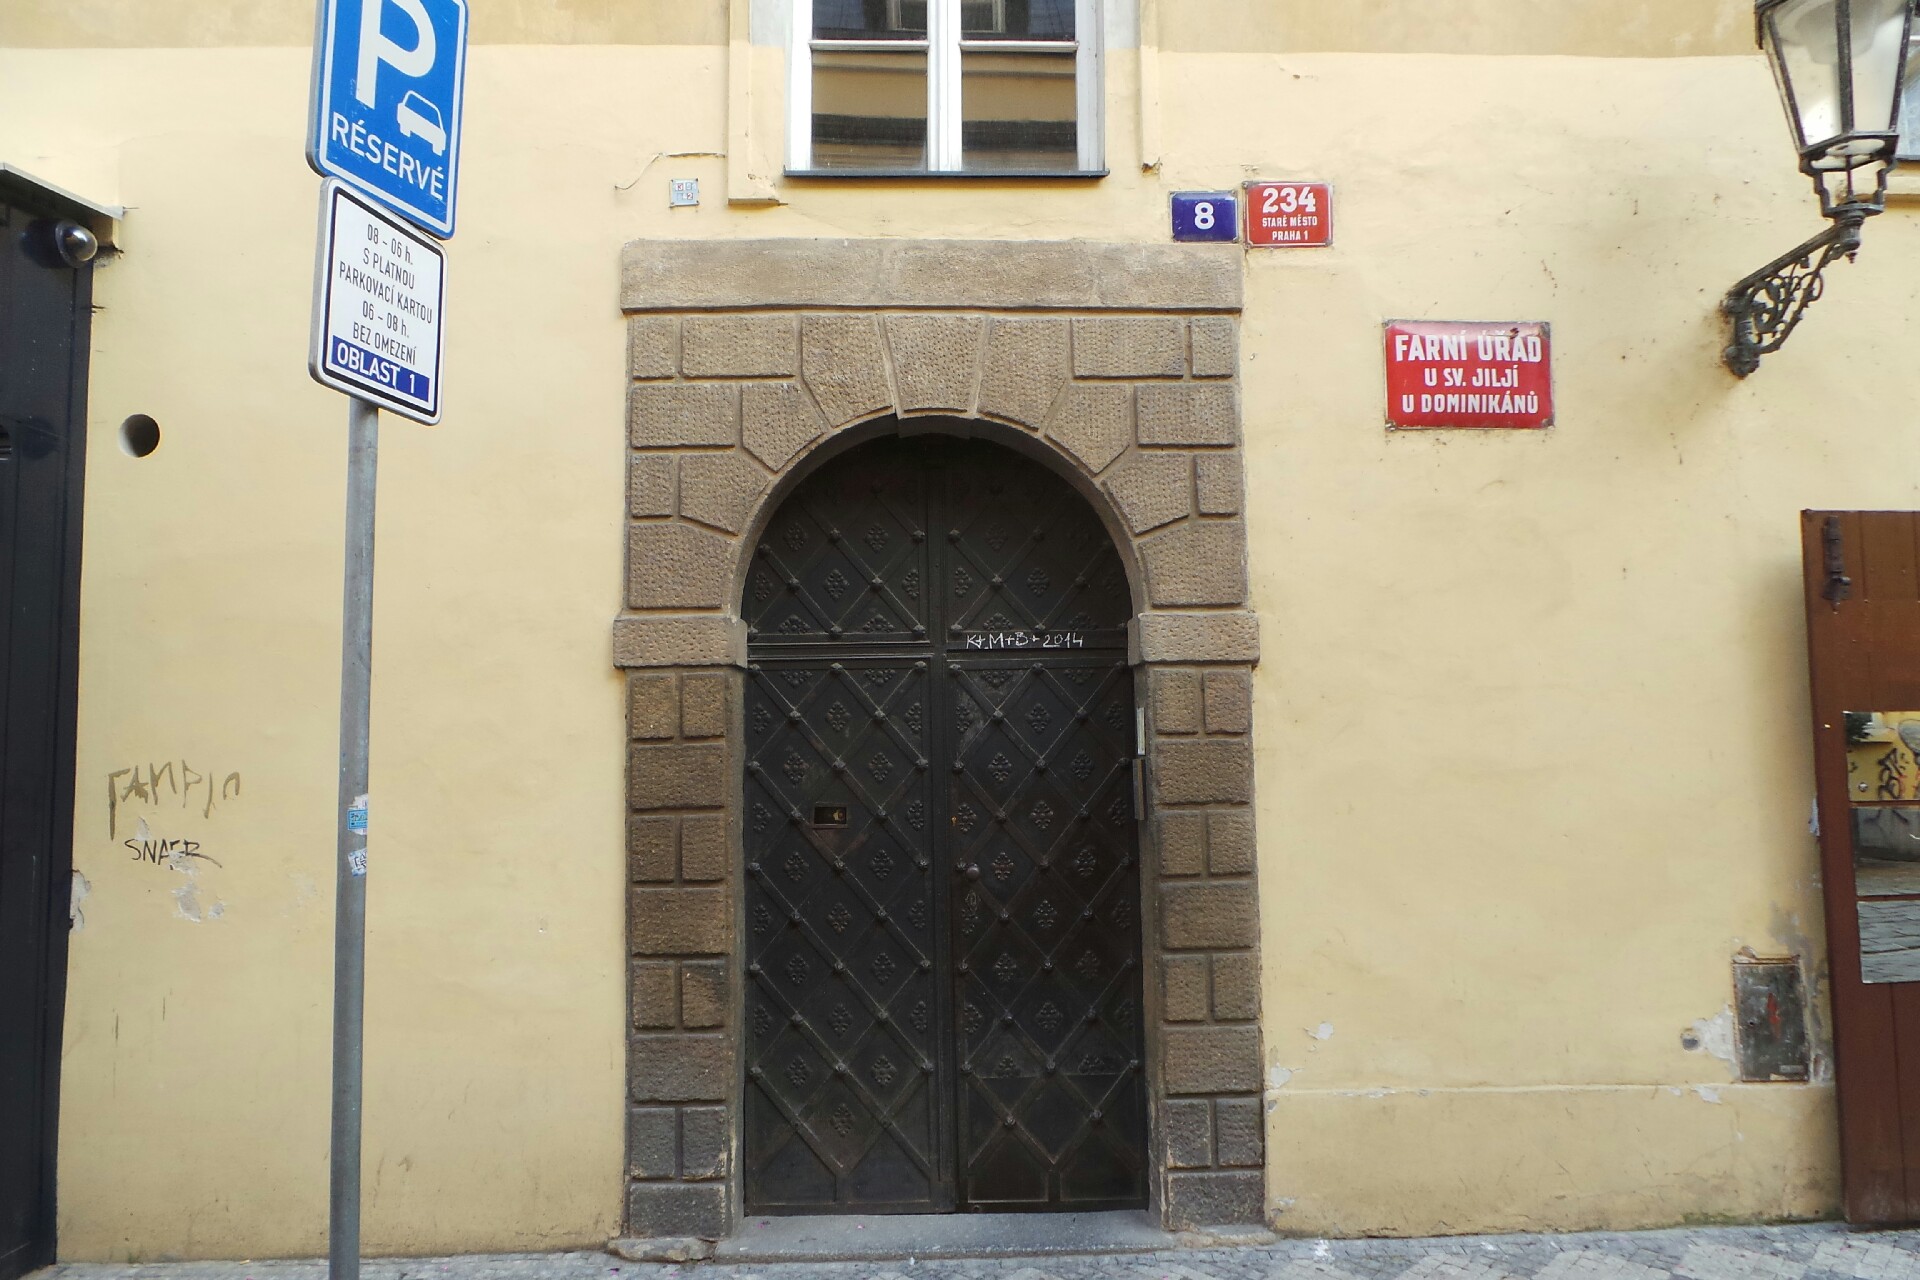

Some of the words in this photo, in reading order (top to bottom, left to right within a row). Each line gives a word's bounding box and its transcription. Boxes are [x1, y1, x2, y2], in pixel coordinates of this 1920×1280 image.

[356, 0, 436, 109] P
[332, 111, 445, 201] RÉSERVÉ
[1194, 202, 1215, 230] 8
[1262, 186, 1316, 214] 234
[1262, 215, 1288, 227] STARÉ
[1290, 214, 1318, 227] MĚSTO
[1272, 230, 1300, 241] PRAHA
[1304, 230, 1309, 241] 1
[367, 224, 379, 244] 08
[391, 238, 402, 258] 06
[405, 246, 413, 265] h.
[363, 248, 370, 265] S
[373, 252, 415, 290] PLATNOU
[339, 261, 395, 305] PARKOVACÍ
[397, 291, 433, 324] KARTOU
[362, 301, 374, 320] 06
[386, 313, 398, 332] 08
[400, 319, 410, 338] h.
[353, 322, 371, 346] BEZ
[374, 332, 417, 365] OMEZENÍ
[1395, 330, 1468, 362] FARNÍ
[337, 343, 400, 388] OBLAST
[409, 374, 415, 394] 1
[1424, 368, 1438, 387] U
[1443, 368, 1466, 387] SV.
[1472, 365, 1519, 388] JILJÍ
[1402, 394, 1414, 413] U
[1421, 391, 1539, 414] DOMINIKÁNŮ
